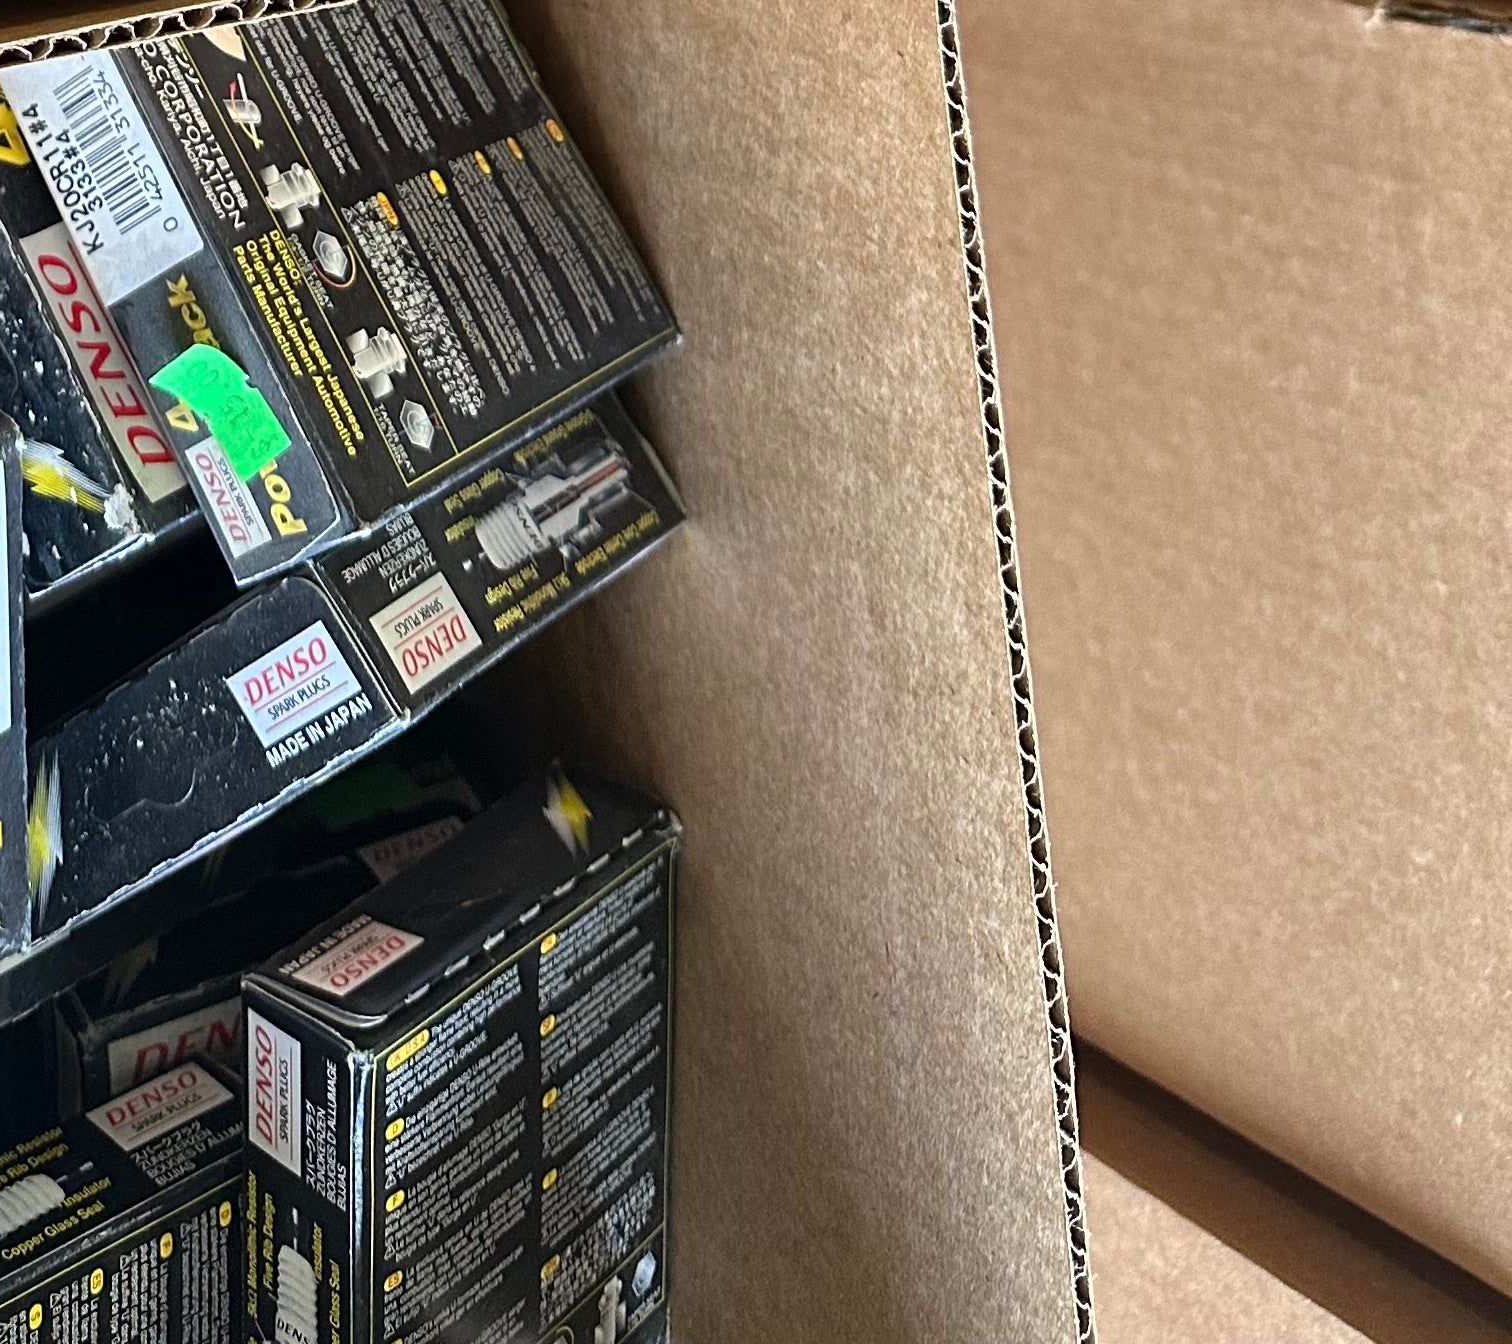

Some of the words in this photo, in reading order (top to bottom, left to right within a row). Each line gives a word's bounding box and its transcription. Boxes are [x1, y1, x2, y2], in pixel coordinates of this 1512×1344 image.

[17, 100, 108, 255] KJ20CR11#4
[52, 126, 106, 213] 3133#4
[156, 65, 245, 230] CORPORATION
[37, 253, 175, 467] DENSO
[257, 232, 280, 264] The
[271, 261, 306, 317] World's
[296, 315, 333, 372] Largest
[323, 368, 367, 443] Japanese
[190, 448, 250, 547] DENSO
[215, 456, 239, 493] PLUGS
[232, 492, 255, 526] SPARK
[239, 634, 334, 708] DENSO
[267, 693, 301, 721] SPARK
[296, 673, 332, 703] PLUGS
[263, 729, 311, 770] MADE
[303, 720, 327, 745] IN
[319, 691, 375, 737] JAPAN
[102, 1062, 202, 1132] DENSO
[251, 1025, 277, 1144] DENSO
[278, 1058, 290, 1099] PLUGS
[277, 1099, 290, 1143] SPARK
